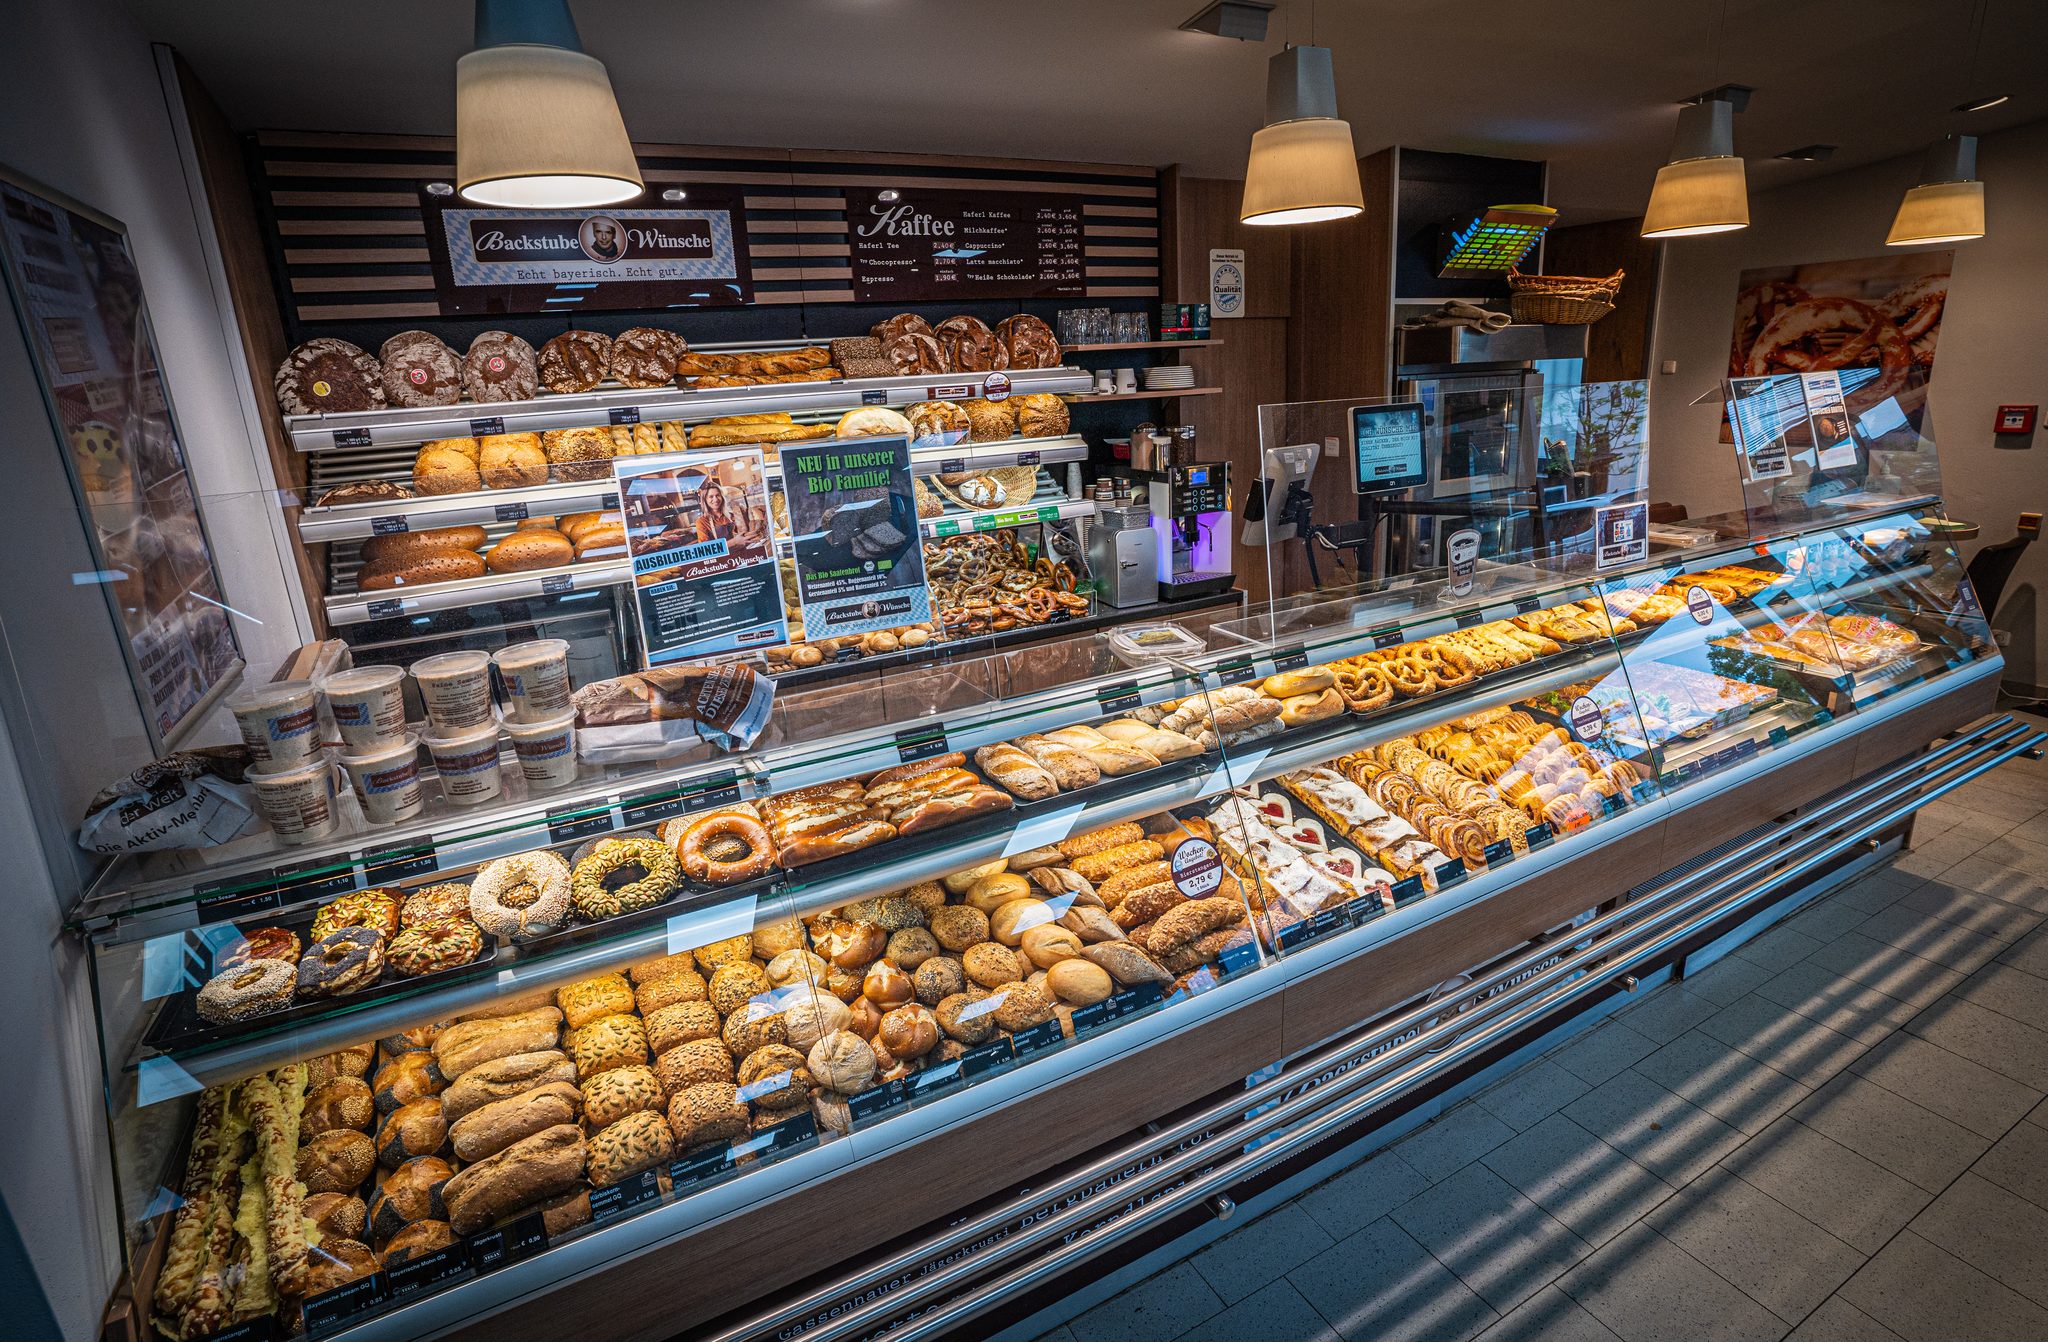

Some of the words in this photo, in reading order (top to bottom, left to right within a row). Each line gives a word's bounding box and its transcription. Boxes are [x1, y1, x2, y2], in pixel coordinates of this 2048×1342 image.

[857, 205, 955, 238] Kaffee
[988, 211, 1011, 219] Kaffee
[476, 231, 579, 252] Backstube
[628, 229, 711, 249] Wünsche
[517, 270, 546, 280] Echt
[553, 267, 622, 281] bayerisch.
[626, 267, 652, 277] Echt
[658, 268, 683, 280] gut.
[862, 276, 894, 284] Espresso
[1214, 285, 1242, 293] Qualität
[796, 455, 823, 474] NEU
[826, 453, 841, 471] in
[844, 450, 895, 469] unserer
[808, 476, 832, 494] Bio
[835, 469, 891, 490] Familie!
[635, 541, 724, 572] AUSBILDER:INNEN
[686, 561, 729, 578] Backstube
[728, 554, 764, 568] Wünsche
[805, 572, 817, 581] Das
[818, 571, 829, 579] Bio
[829, 566, 861, 578] Saatenbrot
[807, 581, 835, 590] Weizenanteil
[848, 575, 876, 585] Roggenanteil
[808, 588, 838, 597] Gerstenanteil
[855, 582, 879, 591] Haferanteil
[826, 610, 862, 621] Backstube
[880, 600, 911, 612] Wünsche
[120, 808, 140, 824] der
[143, 789, 181, 812] Welt
[368, 853, 415, 868] Sonnenblumenkern
[1180, 860, 1215, 879] Bierstangerl
[1189, 875, 1206, 888] 2,79
[1207, 872, 1214, 880] €
[218, 893, 237, 901] Sesam
[848, 1087, 883, 1105] Kartoffelsemmel
[671, 1153, 724, 1177] Sonnenblumensemmel
[591, 1196, 613, 1209] semmel
[473, 1232, 502, 1247] Jägerkrusti
[920, 1226, 1010, 1277] Jägerkrusti
[390, 1264, 421, 1279] Bayerische
[420, 1257, 436, 1267] Mohn
[306, 1294, 339, 1310] Bayerische
[339, 1286, 360, 1298] Sesam
[360, 1282, 370, 1290] GQ
